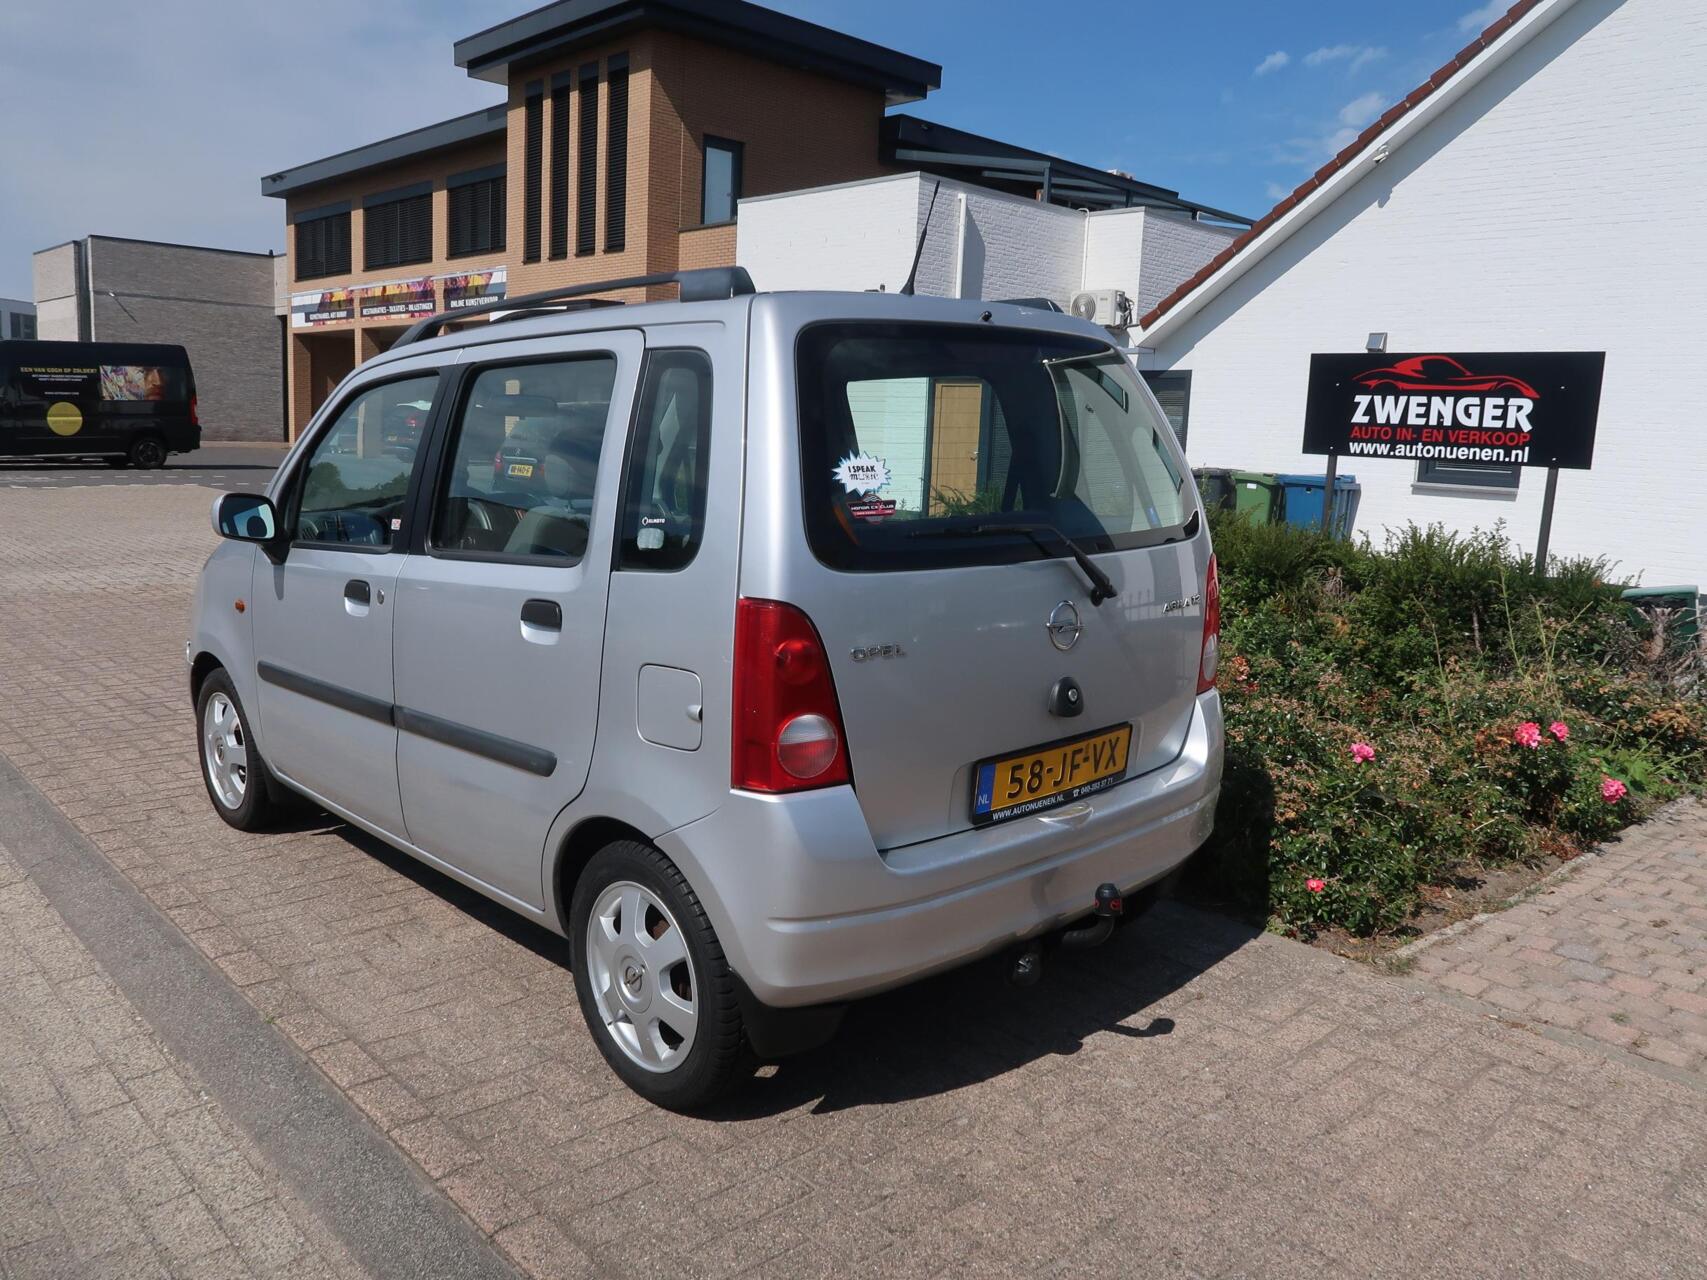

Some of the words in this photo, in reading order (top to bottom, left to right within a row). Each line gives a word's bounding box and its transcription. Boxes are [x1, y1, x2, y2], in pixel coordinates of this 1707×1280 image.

[1350, 394, 1535, 433] ZWENGER
[1350, 426, 1392, 440] AUTO
[1396, 427, 1417, 441] IN-
[1421, 428, 1444, 442] EN
[1448, 430, 1531, 447] VERKOOP
[1349, 441, 1530, 463] www.autonuenen.nl
[852, 465, 876, 473] SPEAK
[848, 643, 907, 662] OPEL
[1006, 736, 1121, 799] 58-JF-VX
[977, 793, 990, 807] NL
[992, 793, 1065, 821] WWW.AUTONUENEN.NL
